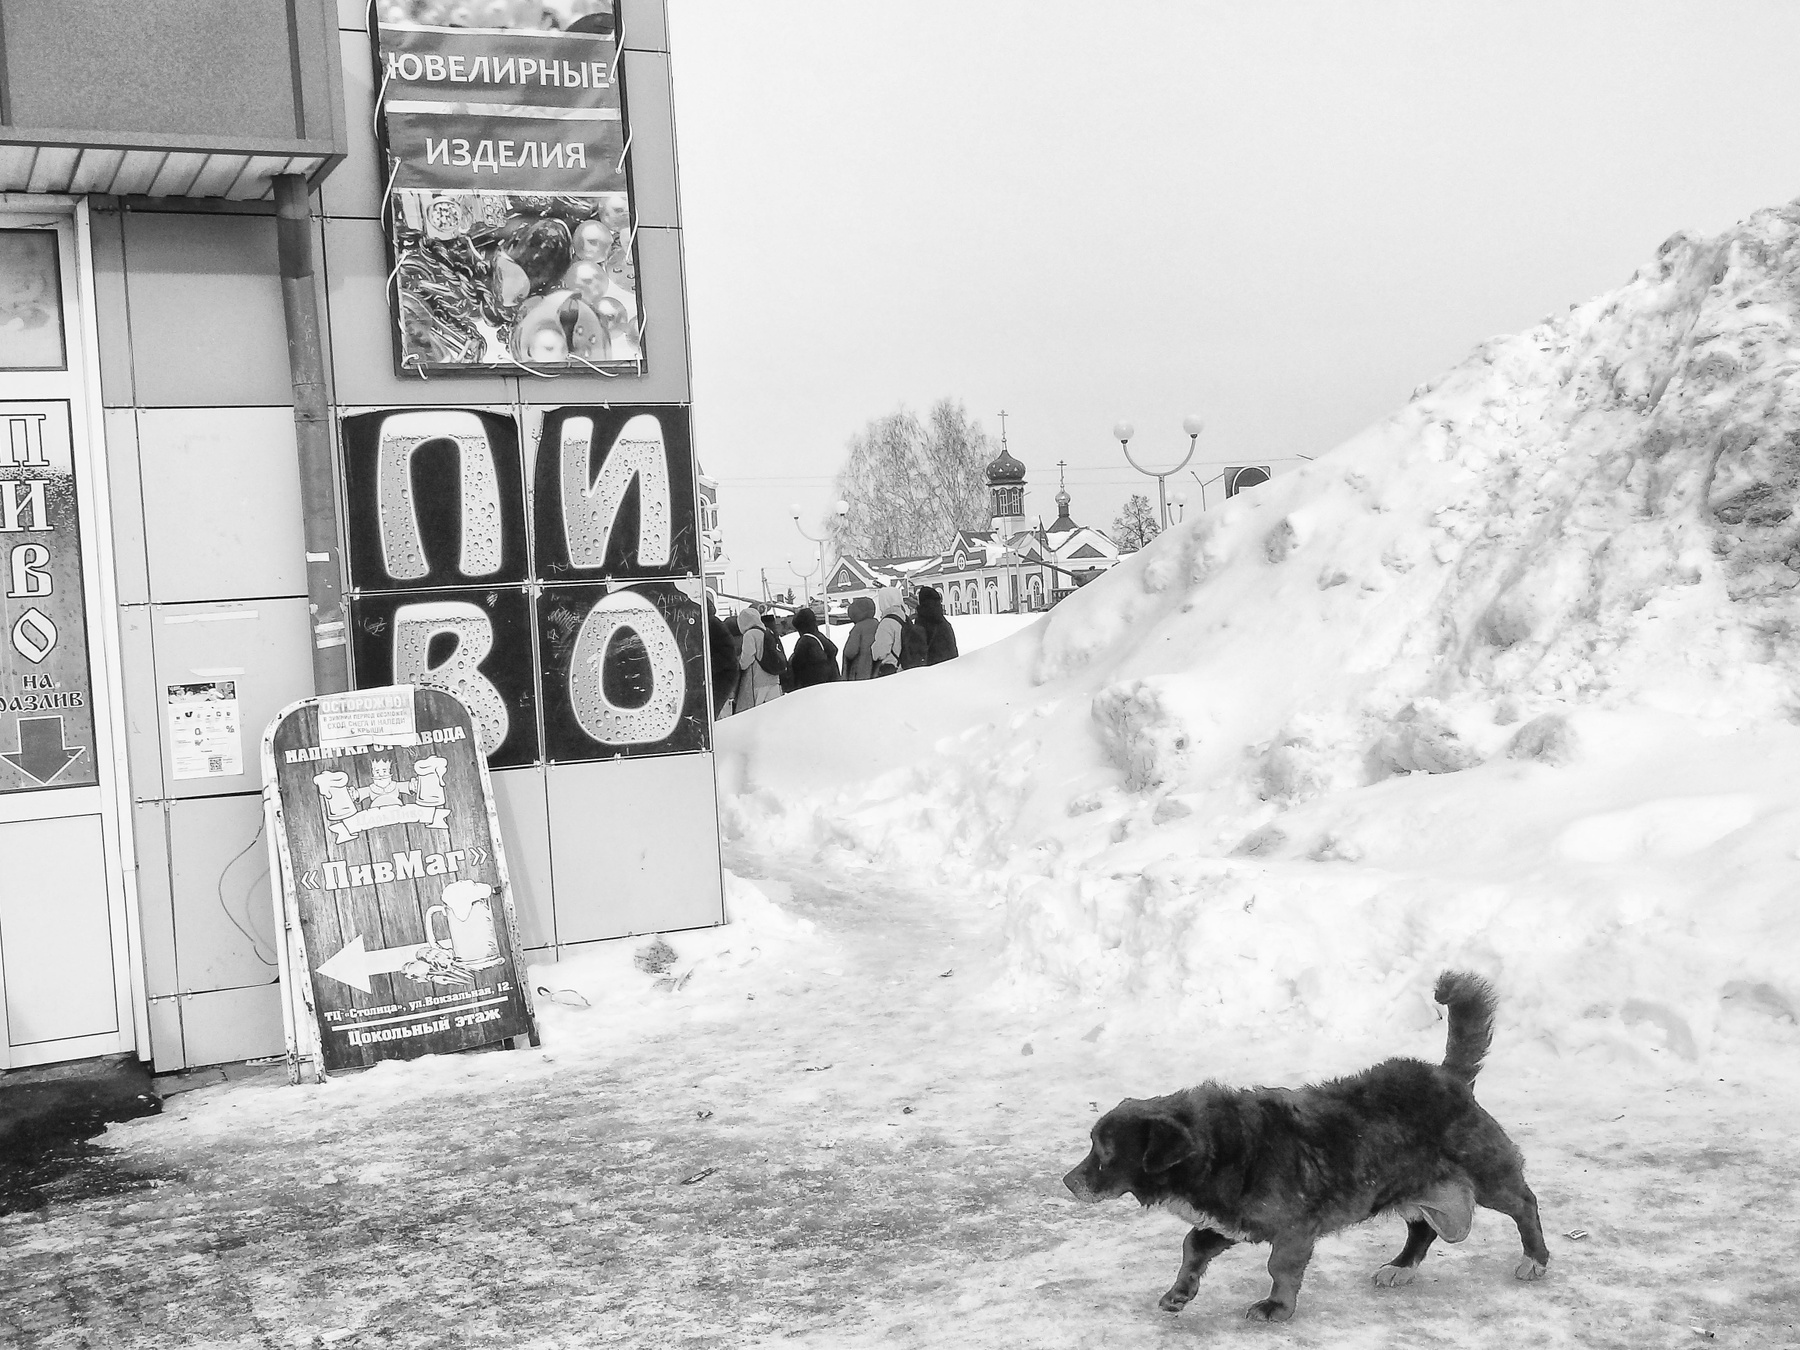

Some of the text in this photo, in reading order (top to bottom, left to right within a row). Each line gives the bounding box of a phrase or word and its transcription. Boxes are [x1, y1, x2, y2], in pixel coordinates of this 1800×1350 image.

[388, 52, 610, 89] ЮВЕЛИРНЫЕ
[425, 138, 587, 174] ИЗДЕЛИЯ
[22, 673, 54, 691] НА
[327, 721, 347, 730] СХОД
[348, 719, 369, 727] СНЕГА
[377, 717, 406, 726] НАЛЕДИ
[357, 726, 385, 735] КРЫШИ
[415, 725, 466, 746] АВОДА
[347, 1008, 502, 1047] Цокольный этаж
